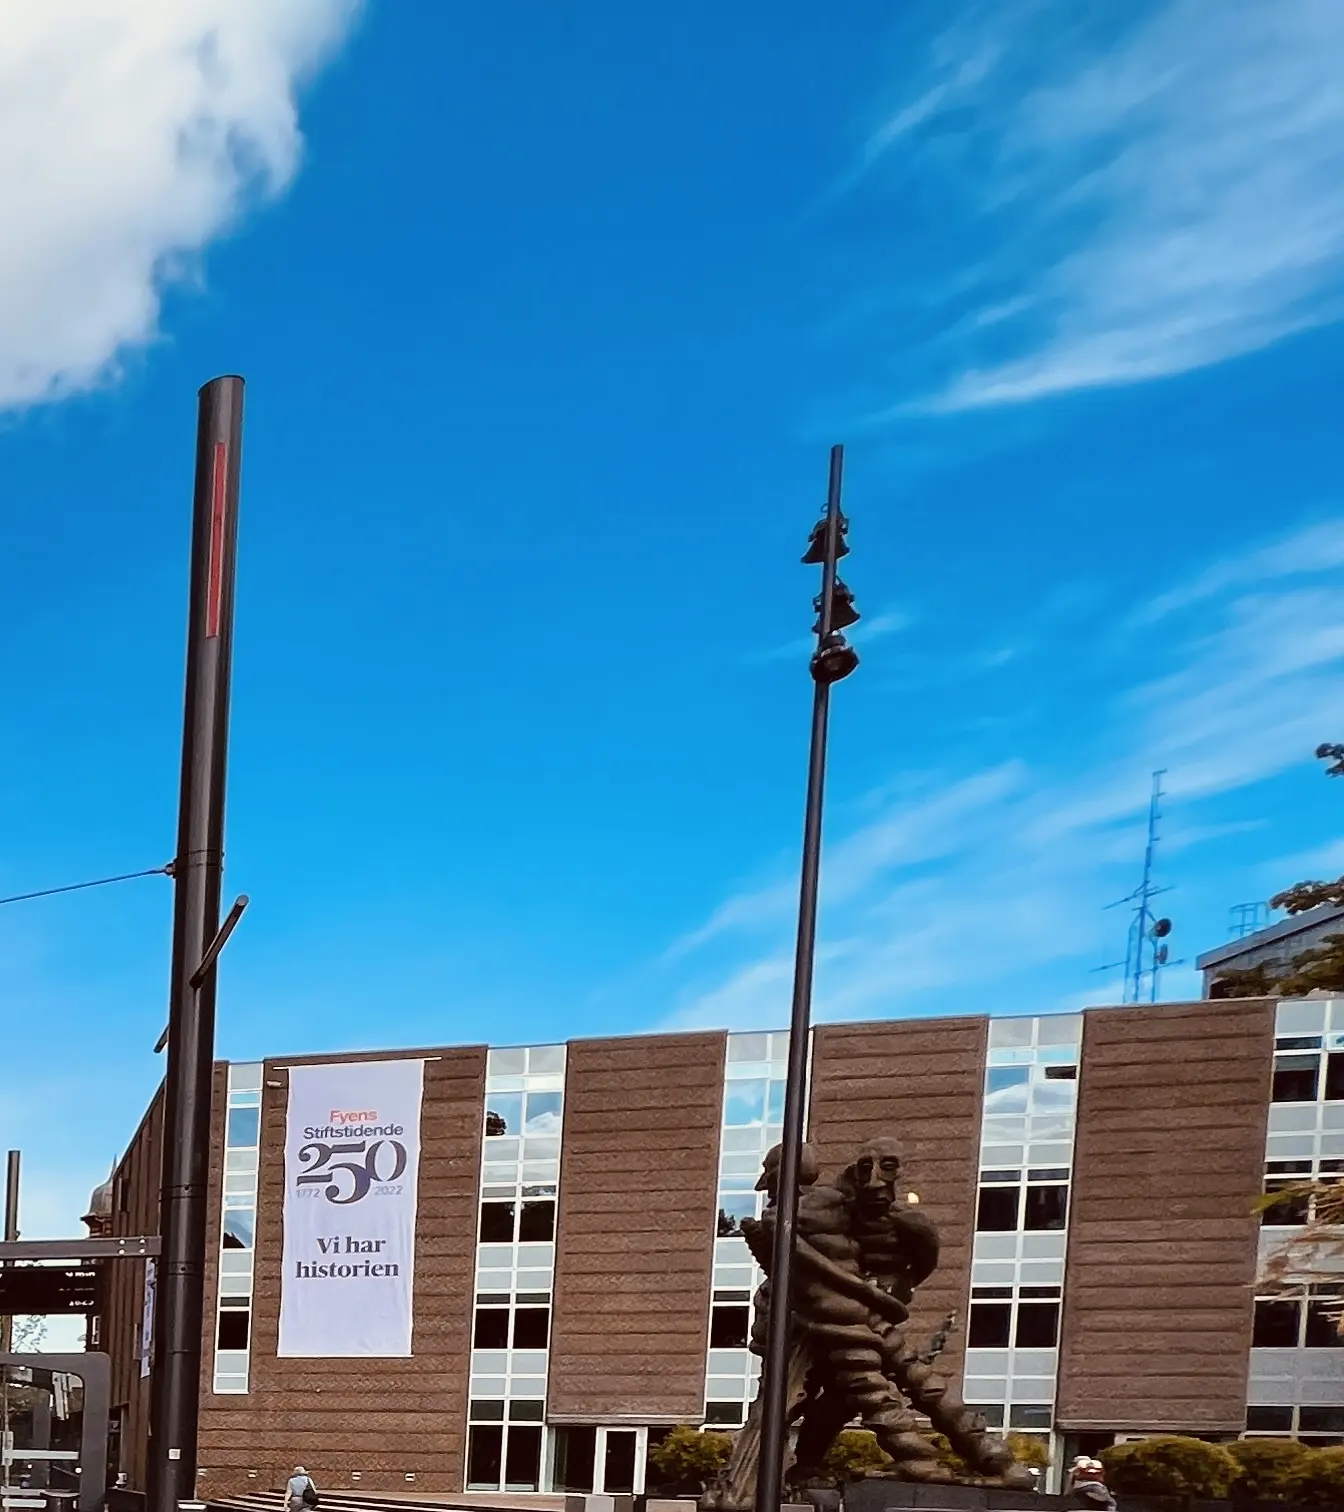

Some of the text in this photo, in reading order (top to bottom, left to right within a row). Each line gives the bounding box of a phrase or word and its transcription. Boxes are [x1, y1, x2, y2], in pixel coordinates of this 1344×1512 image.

[330, 1110, 378, 1124] Fyens
[303, 1123, 404, 1139] Stiftstidende
[296, 1140, 407, 1204] 250
[296, 1188, 320, 1198] 1772
[374, 1186, 403, 1195] 2022
[316, 1236, 386, 1254] Vi har
[295, 1260, 399, 1278] historien
